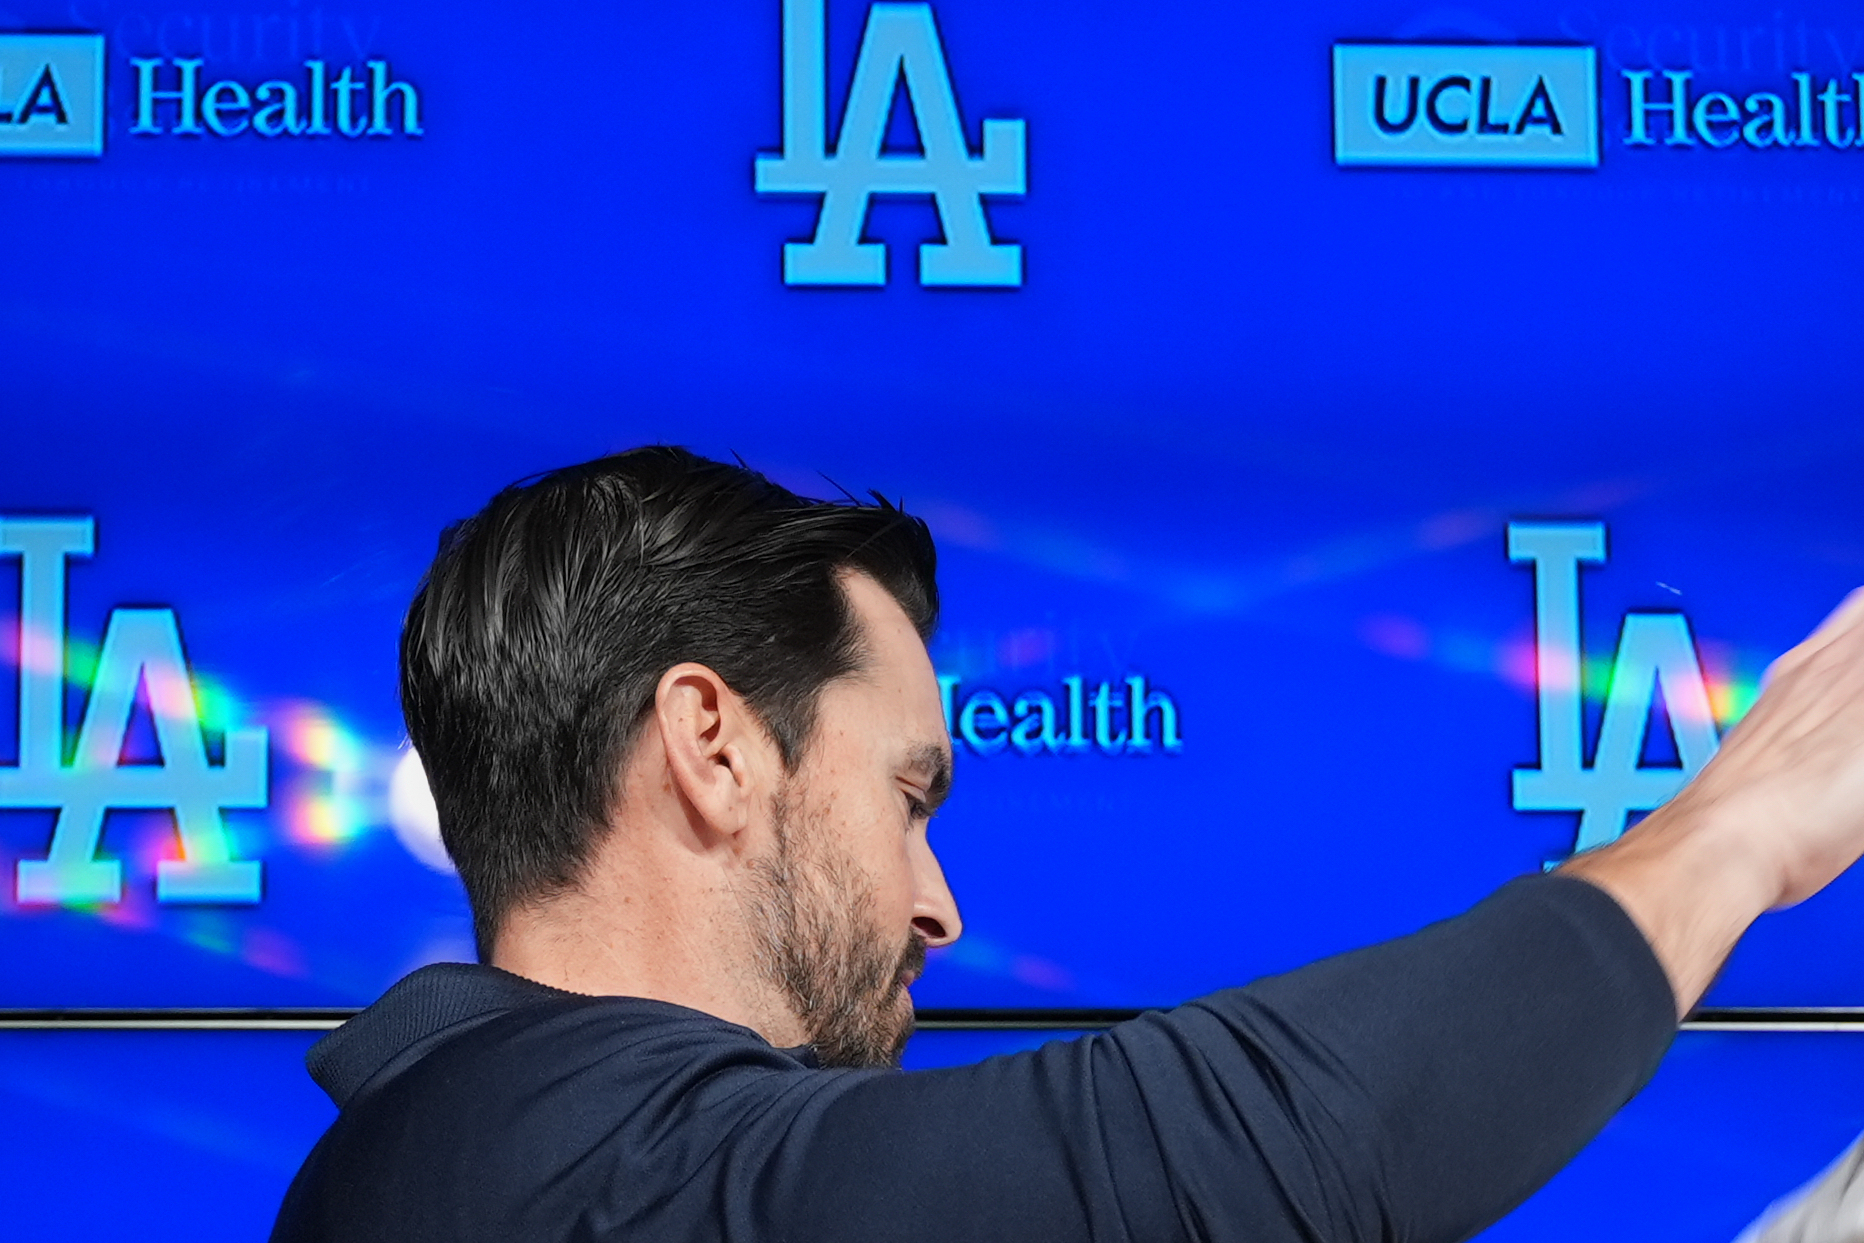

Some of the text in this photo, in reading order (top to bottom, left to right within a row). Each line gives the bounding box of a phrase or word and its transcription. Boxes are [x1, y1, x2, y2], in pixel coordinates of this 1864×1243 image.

[131, 57, 423, 137] Health
[754, 0, 1027, 286] LA
[1374, 75, 1563, 137] UCLA
[0, 514, 269, 906] LA
